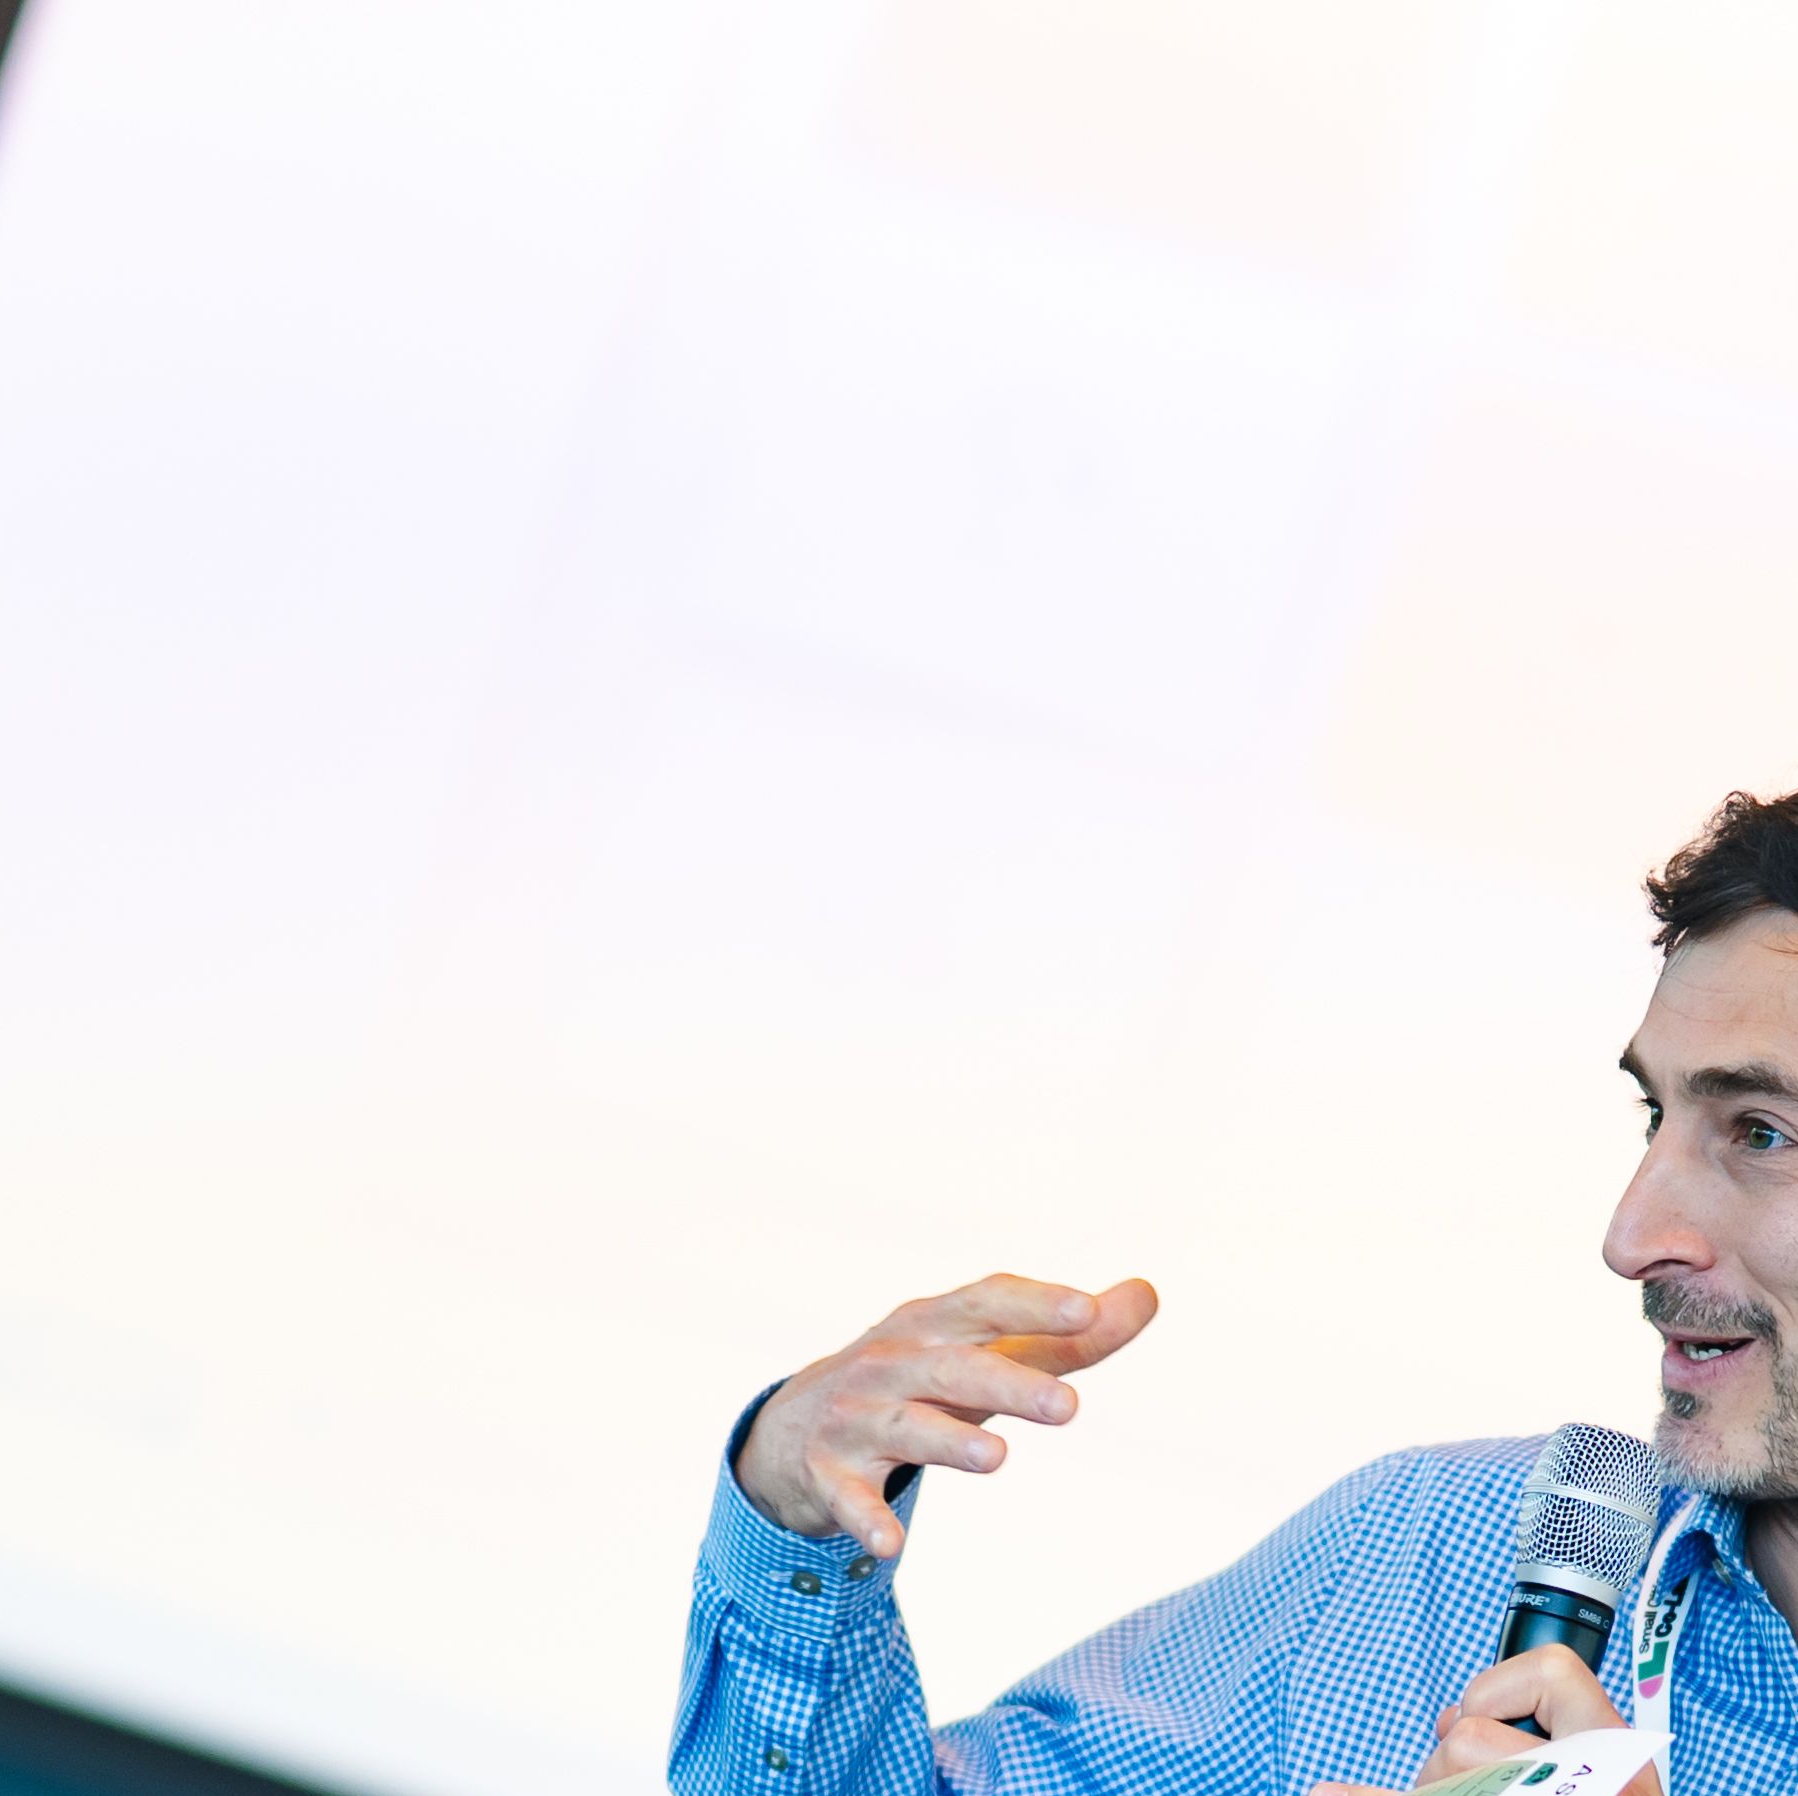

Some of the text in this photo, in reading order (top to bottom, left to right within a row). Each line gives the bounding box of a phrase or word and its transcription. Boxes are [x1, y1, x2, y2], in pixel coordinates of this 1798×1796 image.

[1655, 1574, 1690, 1638] Co-L
[1639, 1611, 1657, 1654] Small
[1571, 1763, 1592, 1776] A
